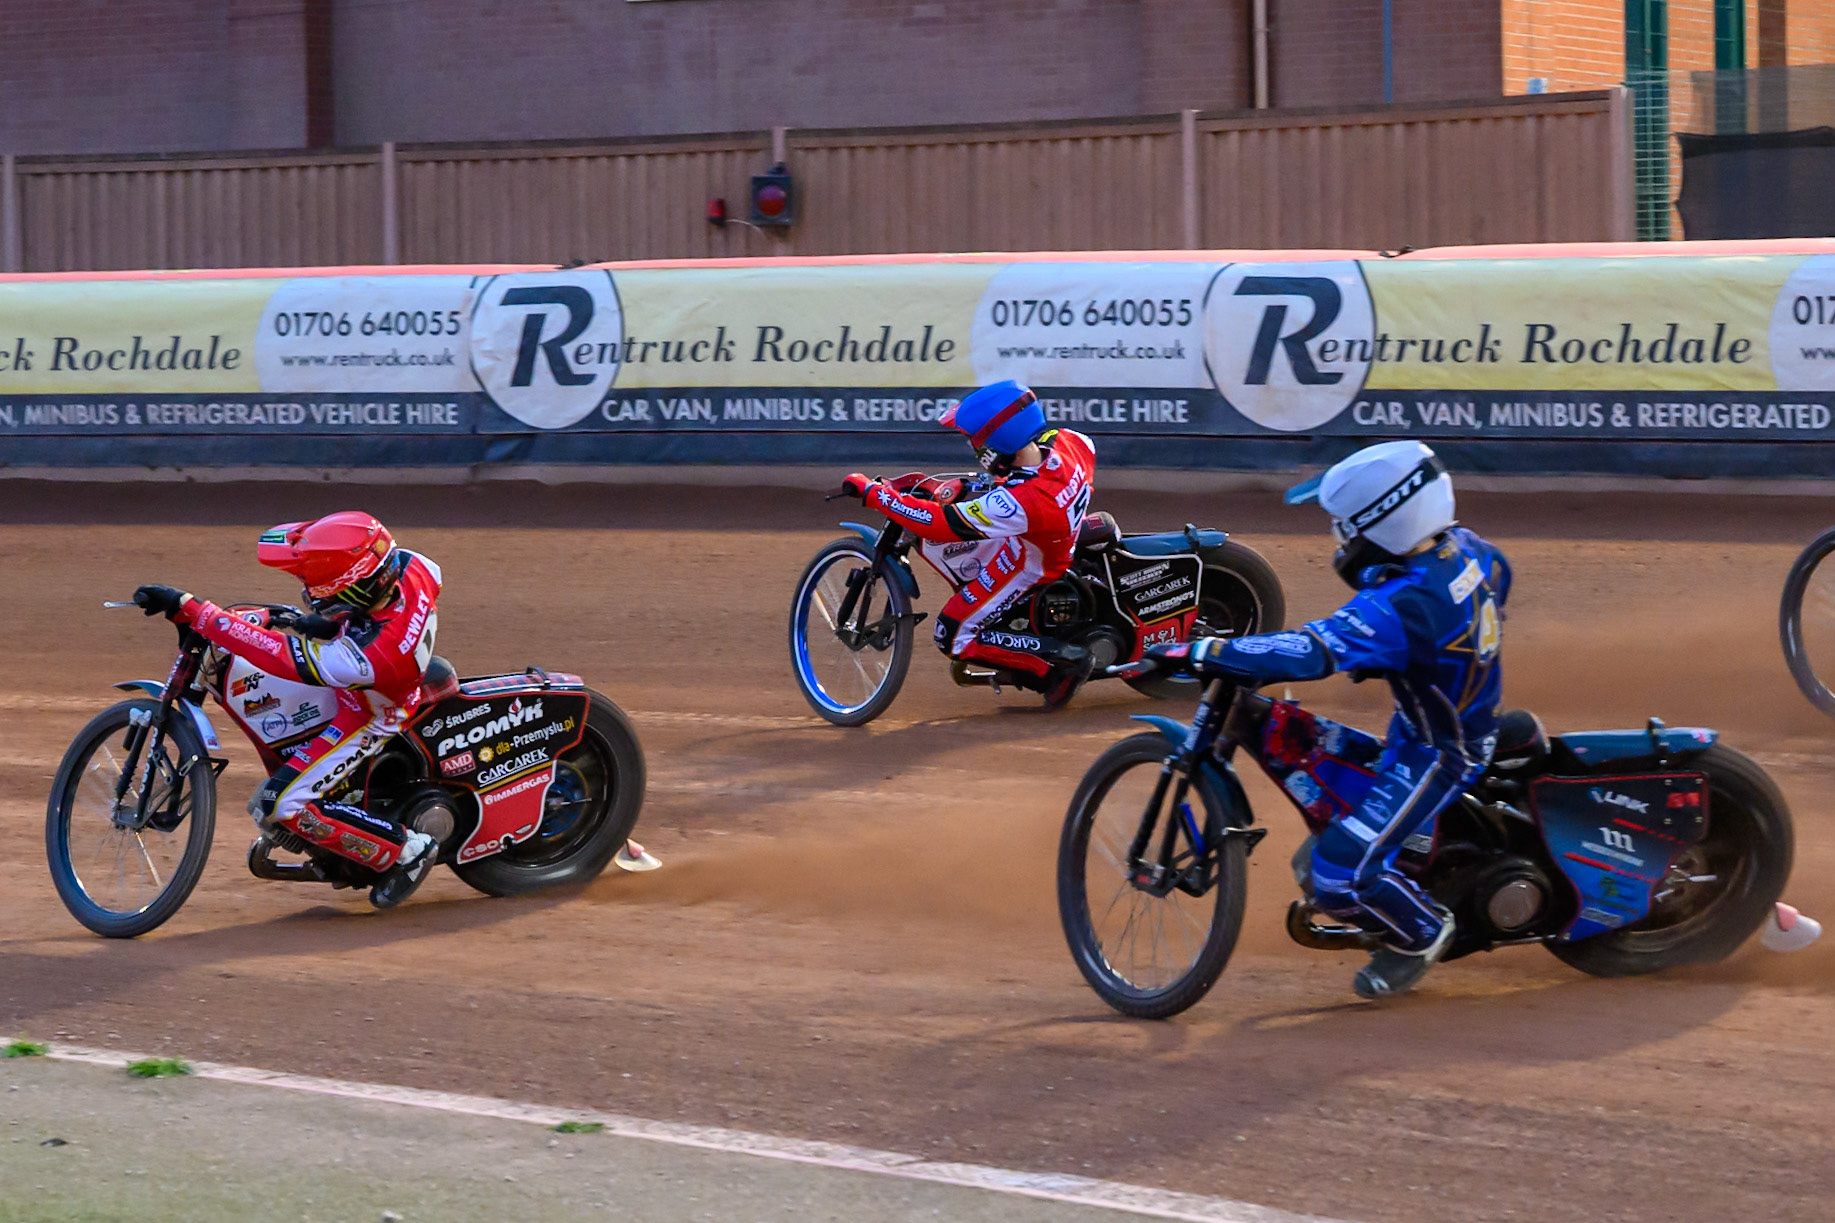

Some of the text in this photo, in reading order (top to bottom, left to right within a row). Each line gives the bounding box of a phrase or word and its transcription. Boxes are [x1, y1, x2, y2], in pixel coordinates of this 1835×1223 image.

[275, 310, 461, 337] 01706 640055
[992, 299, 1192, 326] 01706 640055
[500, 285, 956, 387] Rentruck Rochdale
[1233, 276, 1753, 386] Rentruck Rochdale
[48, 335, 242, 371] Rochdale
[280, 347, 456, 367] www.rentruck.co.uk
[997, 340, 1186, 359] www.rentruck.co.uk
[24, 404, 120, 425] MINIBUS
[125, 403, 142, 425] &
[146, 403, 307, 425] REFRIGERATED
[310, 403, 401, 425] VEHICLE
[405, 403, 459, 425] HIRE
[657, 398, 718, 424] VAN,
[723, 398, 825, 422] MINIBUS
[830, 398, 848, 422] &
[854, 398, 960, 422] REFRIGE
[1132, 399, 1190, 423] HIRE
[1353, 401, 1832, 430] CAR, VAN, MINIBUS & REFRIGERATED
[890, 498, 933, 523] burnside
[992, 493, 1012, 514] ATPI
[1356, 470, 1425, 528] SCOTT
[398, 588, 430, 655] BEWLEY
[231, 621, 283, 651] KRAJEWSKI
[445, 703, 492, 728] ŚRUBRES
[444, 753, 473, 771] AMD
[477, 747, 550, 785] GARCAREK
[492, 773, 551, 803] IMMERGAS
